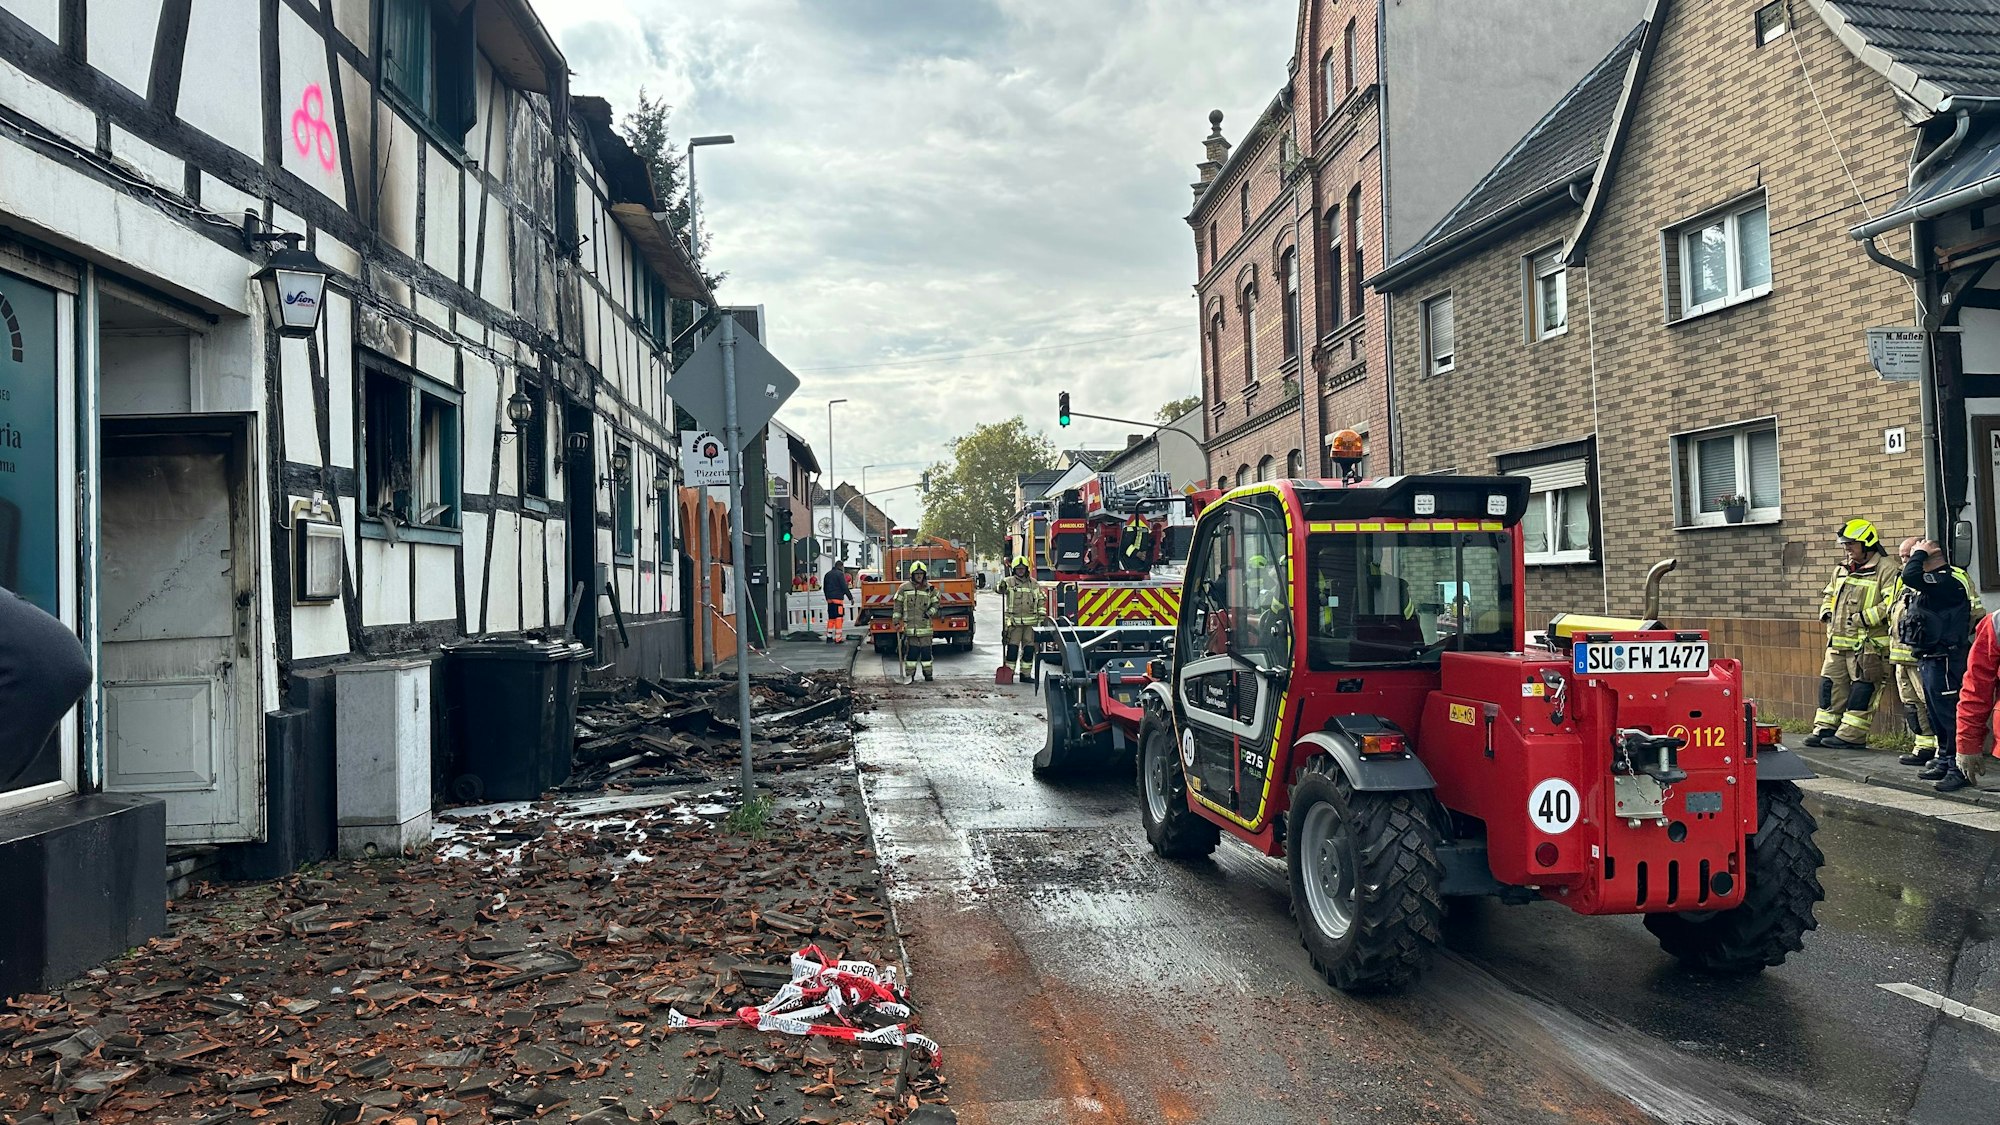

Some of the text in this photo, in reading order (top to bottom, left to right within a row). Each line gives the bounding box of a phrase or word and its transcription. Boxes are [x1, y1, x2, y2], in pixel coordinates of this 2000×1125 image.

[1888, 433, 1902, 448] 61
[695, 469, 730, 478] Pizzeria
[1578, 661, 1584, 669] D
[1588, 645, 1705, 669] SU FW 1477
[1692, 726, 1726, 747] 112
[1184, 735, 1193, 760] 40
[1538, 789, 1571, 823] 40
